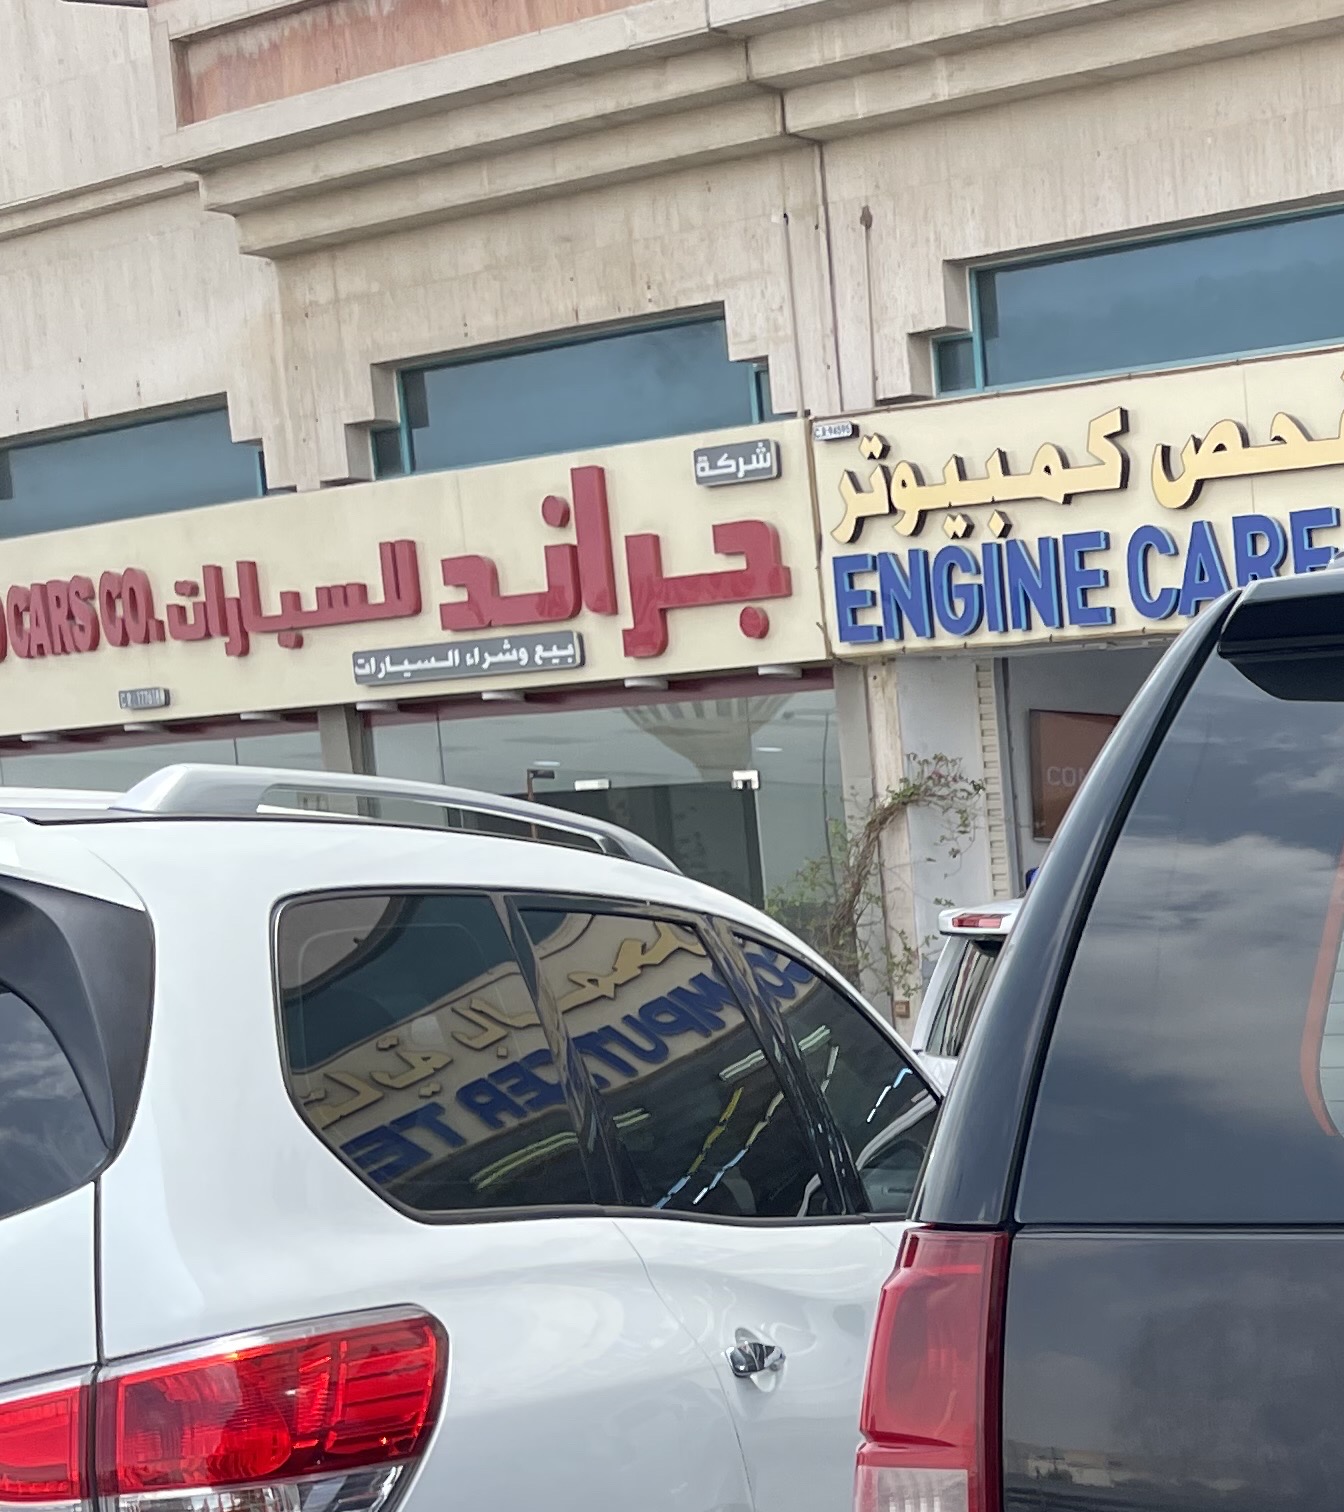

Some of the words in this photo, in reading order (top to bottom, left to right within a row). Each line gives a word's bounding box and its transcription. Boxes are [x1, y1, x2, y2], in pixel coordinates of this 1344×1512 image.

[696, 442, 771, 478] شركة
[831, 406, 1130, 544] كمبيوتر
[167, 539, 423, 657] للسيارات
[440, 465, 792, 658] جراند
[832, 530, 1115, 643] ENGINE
[1127, 507, 1341, 620] CARE
[7, 575, 100, 659] CARS
[466, 639, 528, 669] وشراء
[535, 642, 575, 665] بيع
[355, 649, 460, 678] السيارات
